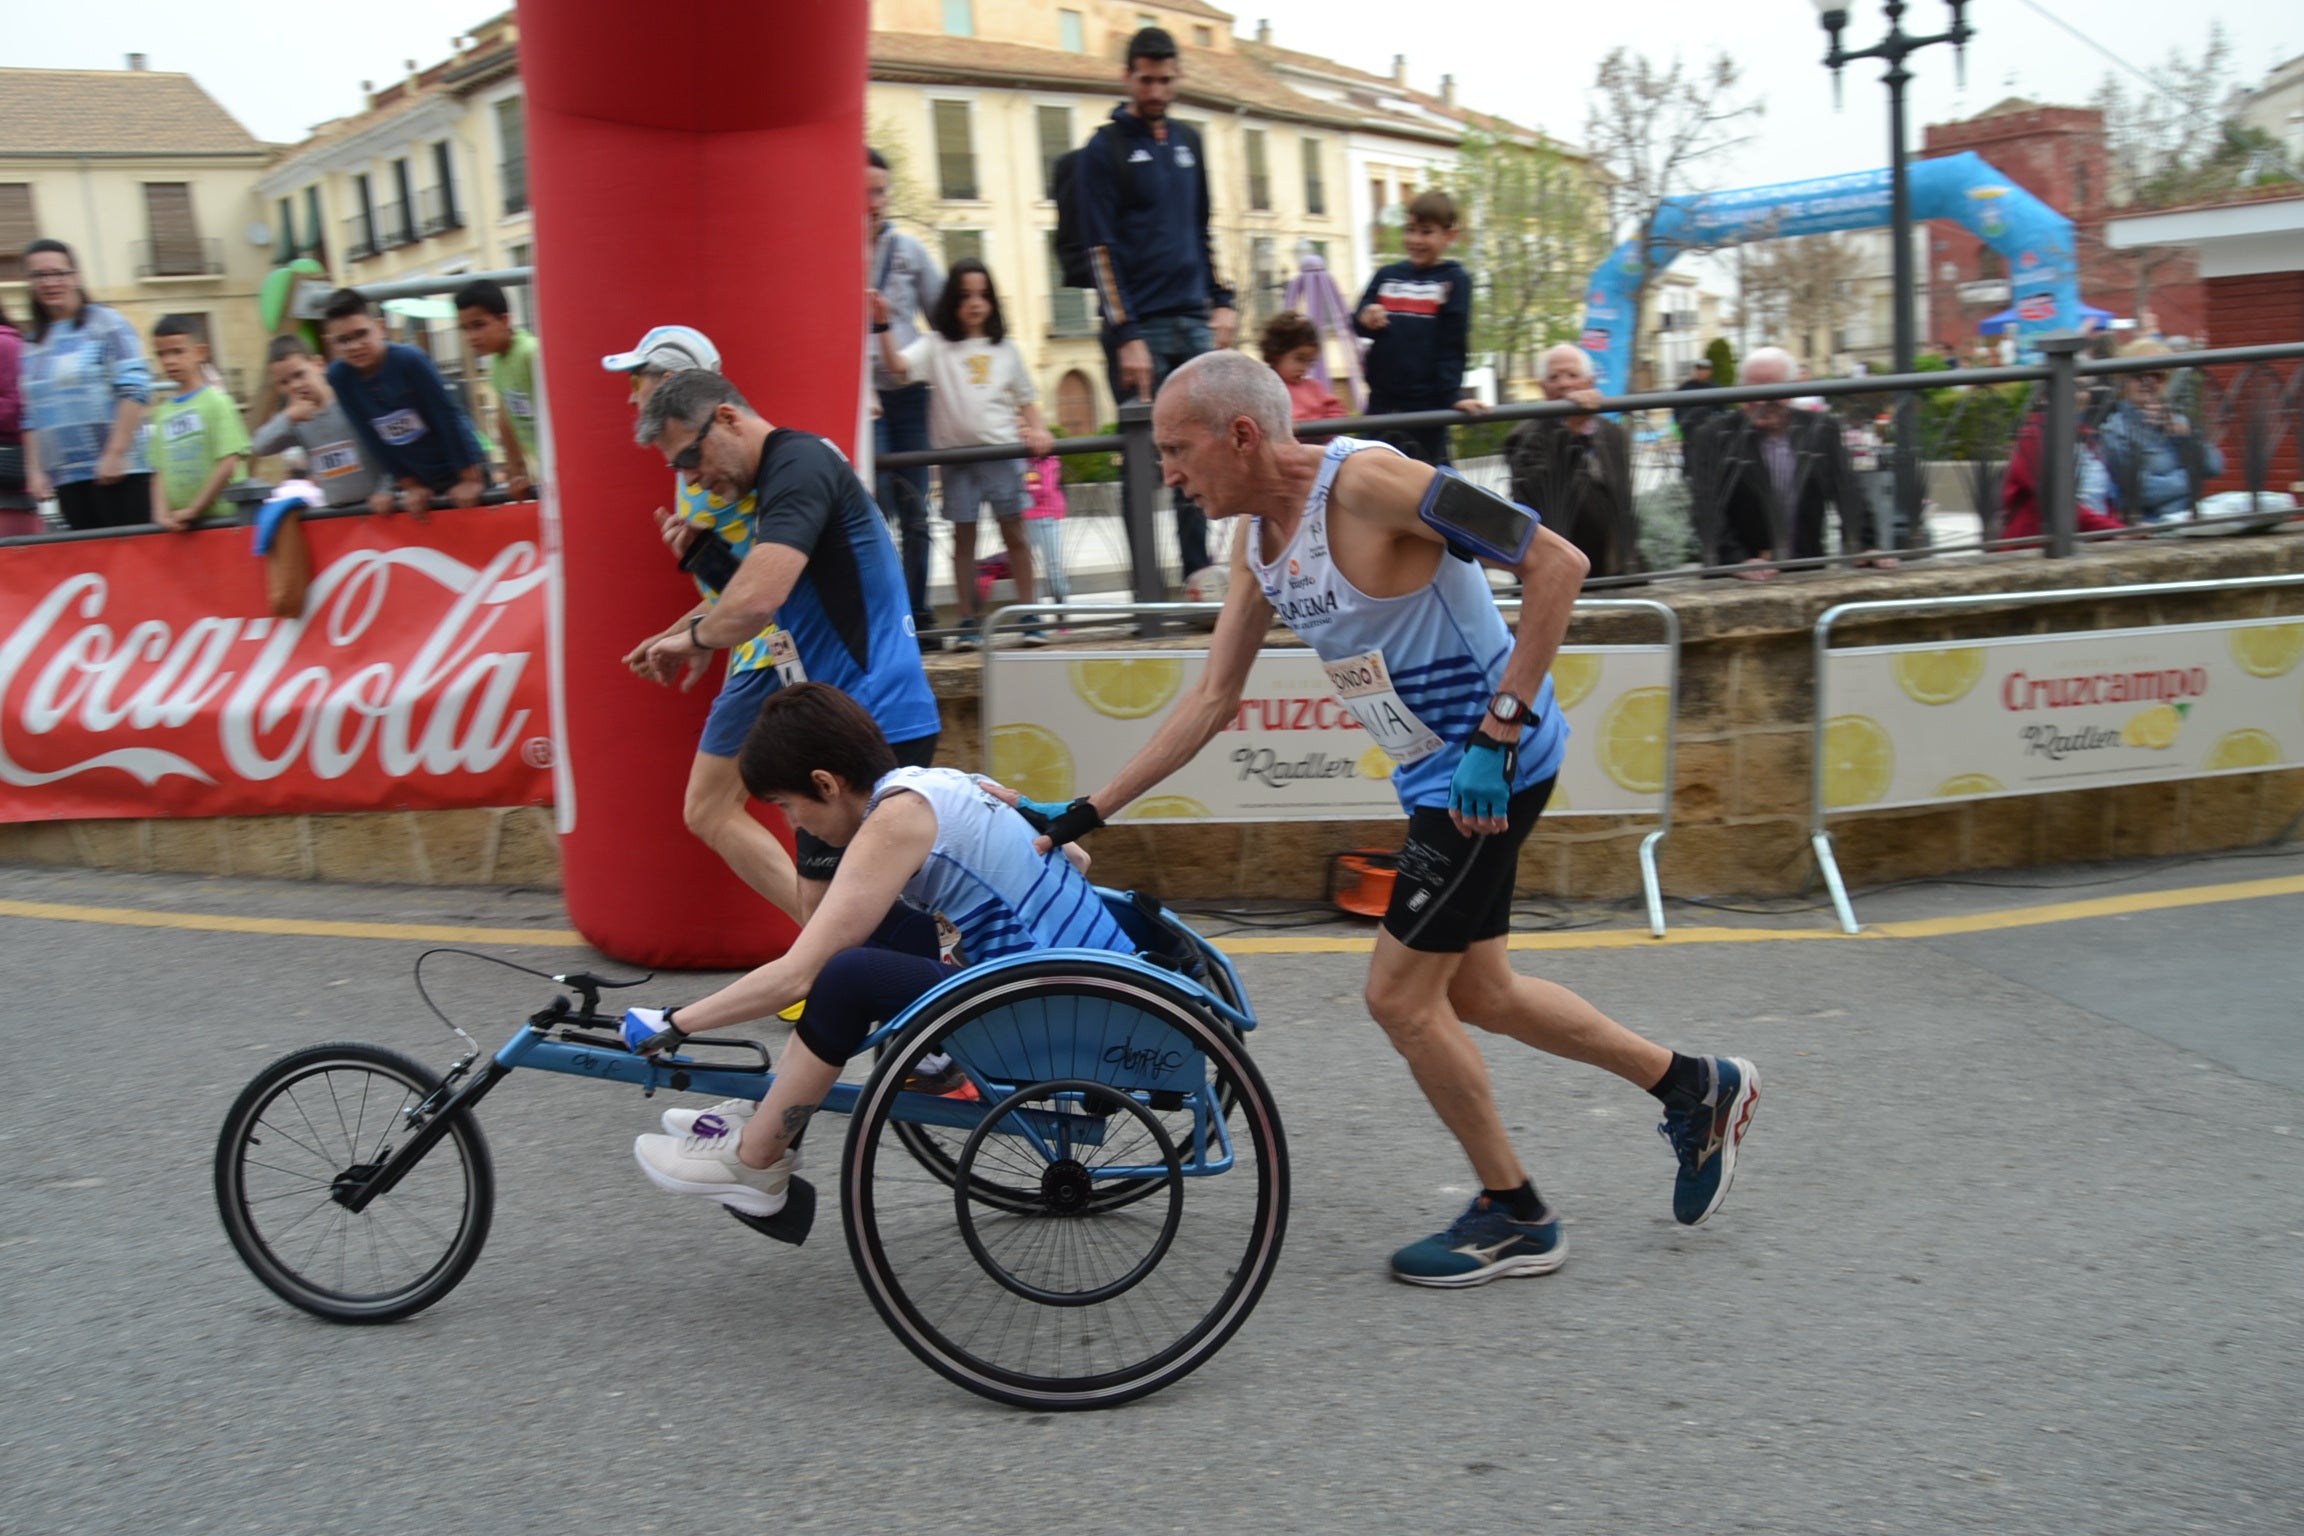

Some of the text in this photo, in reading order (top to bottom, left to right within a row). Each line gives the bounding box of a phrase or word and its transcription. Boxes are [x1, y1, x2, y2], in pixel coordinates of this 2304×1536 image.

[0, 541, 548, 786] Coca-Cola
[2004, 667, 2208, 711] Cruzcampo
[2020, 723, 2122, 760] Radler
[1230, 747, 1359, 788] Radler
